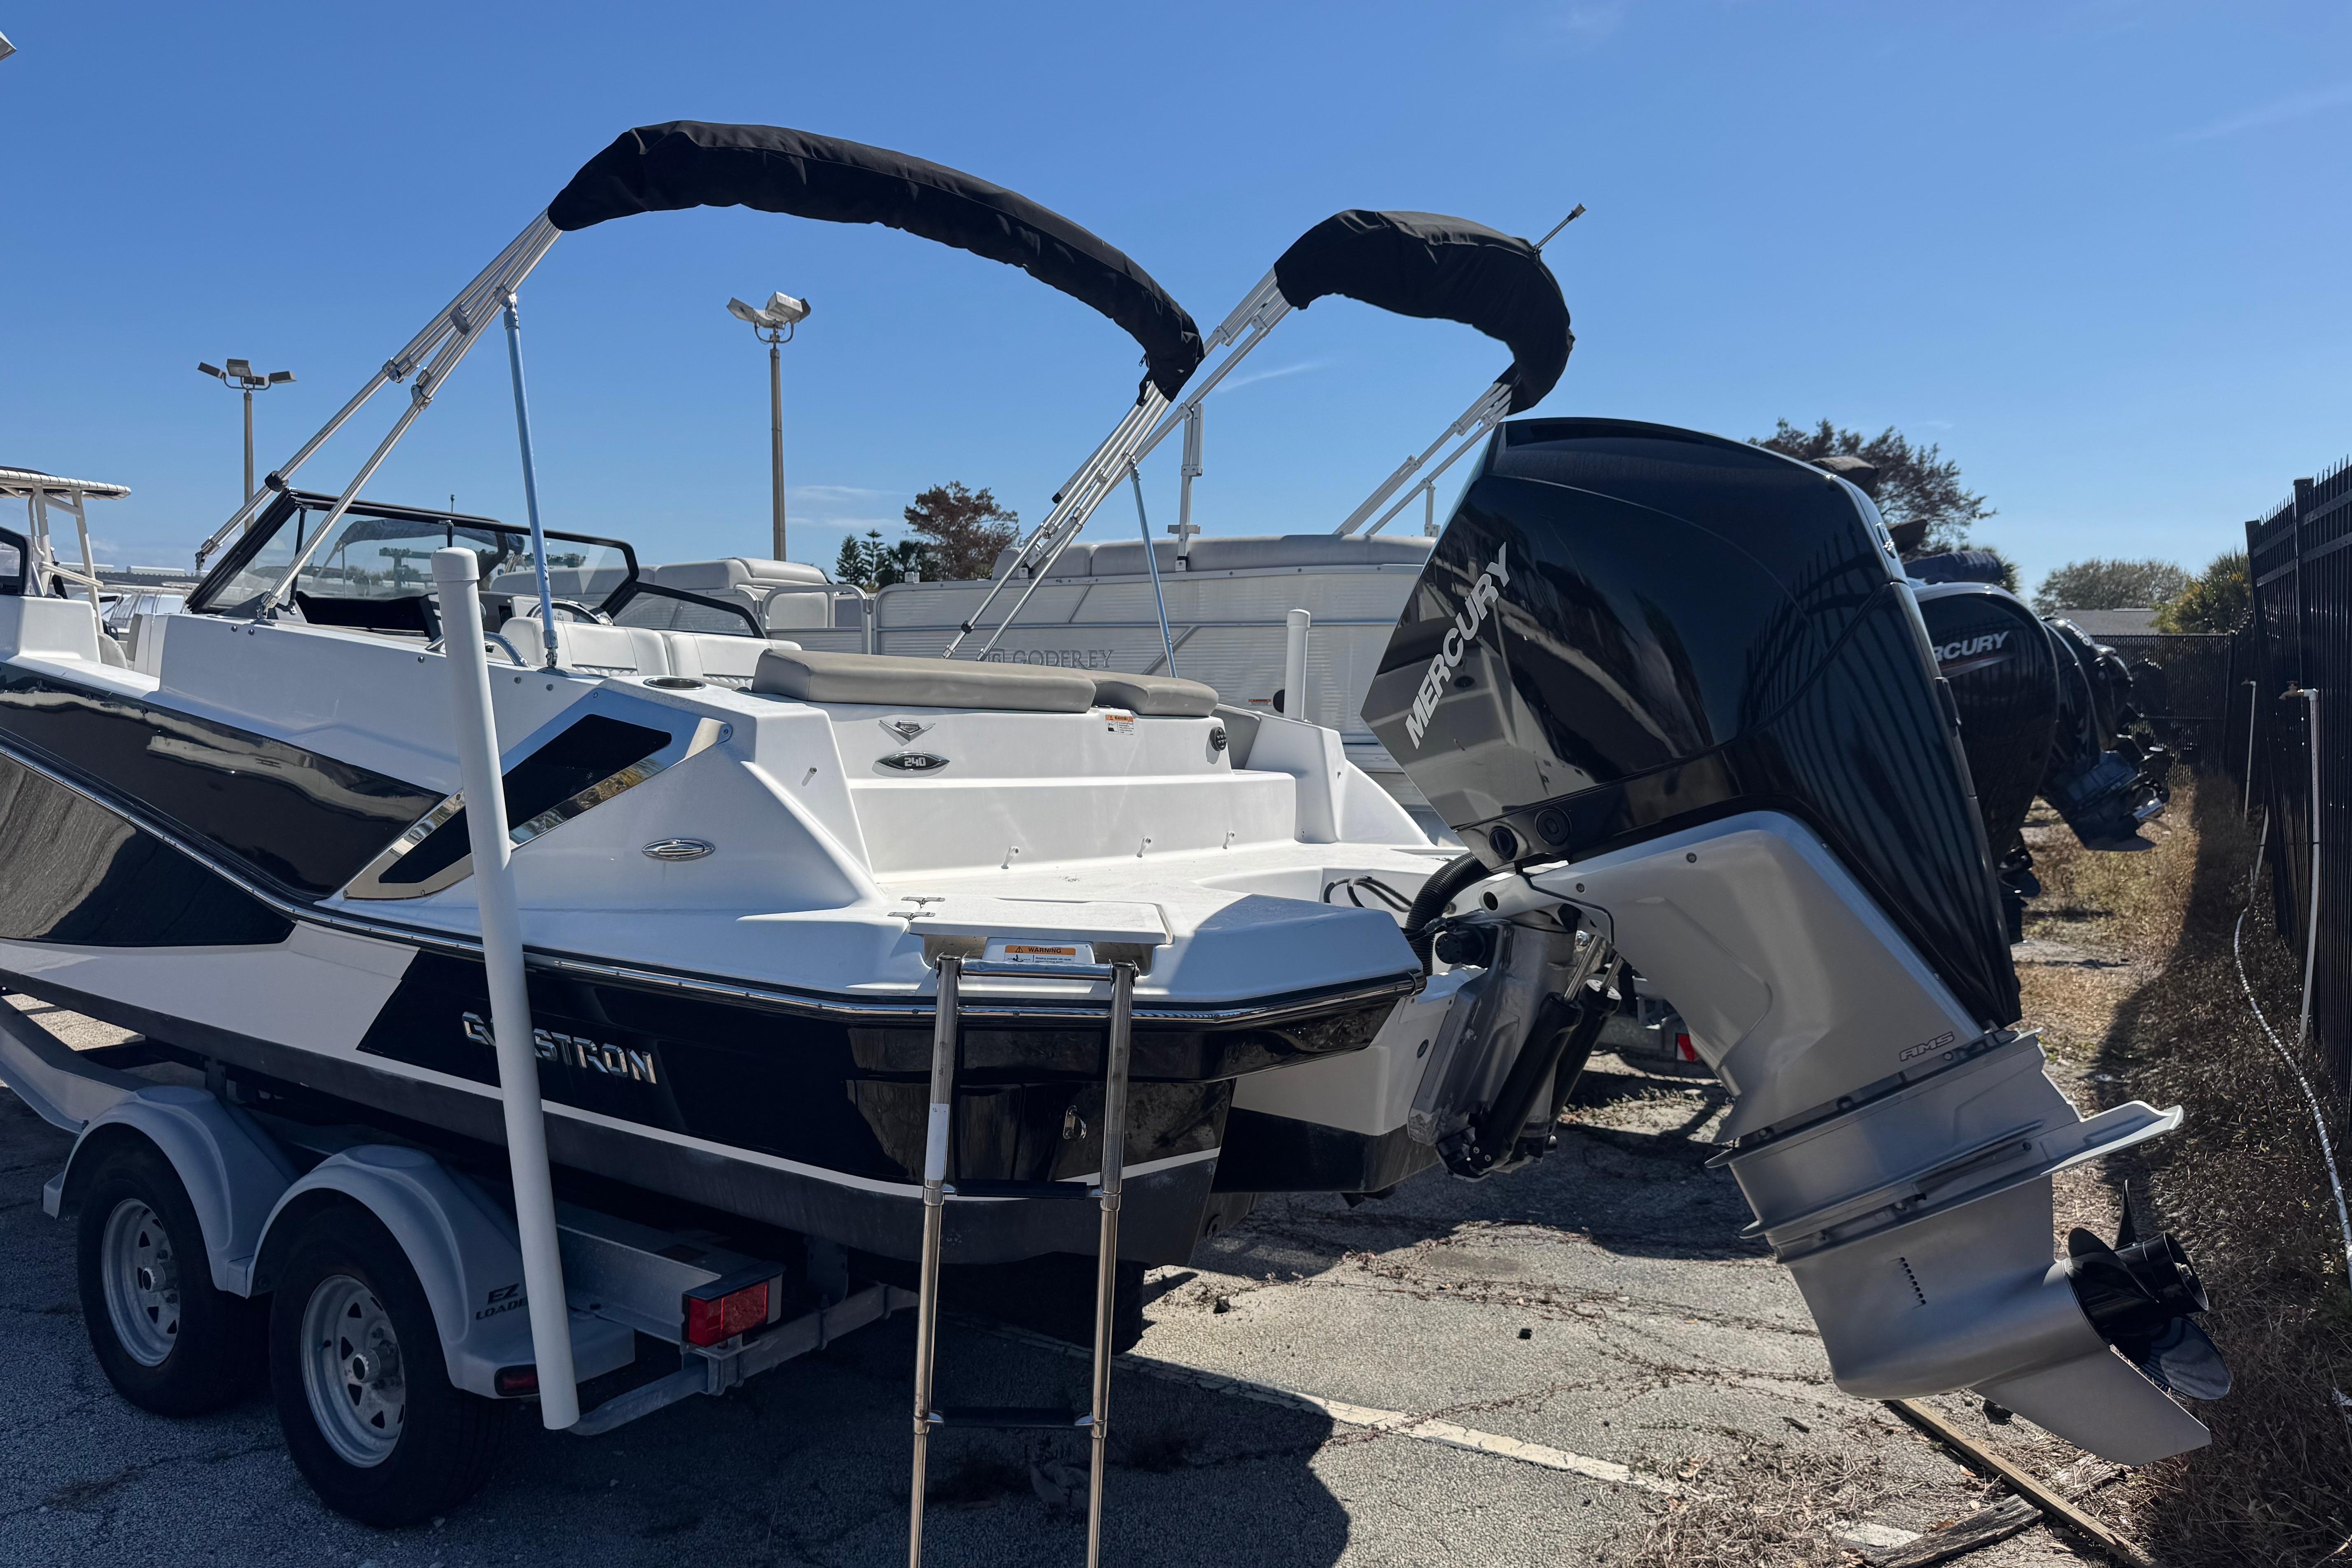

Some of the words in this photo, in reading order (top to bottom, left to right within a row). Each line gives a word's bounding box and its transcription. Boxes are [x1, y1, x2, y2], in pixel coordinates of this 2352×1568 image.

[1405, 542, 1510, 749] MERCURY
[1933, 630, 2009, 662] RCURY
[1011, 650, 1113, 670] GODFREY
[904, 757, 926, 766] 240
[462, 1011, 657, 1084] GSTRON
[1899, 1031, 1955, 1062] AMS
[488, 1283, 520, 1305] EZ
[476, 1297, 528, 1320] LOADE
